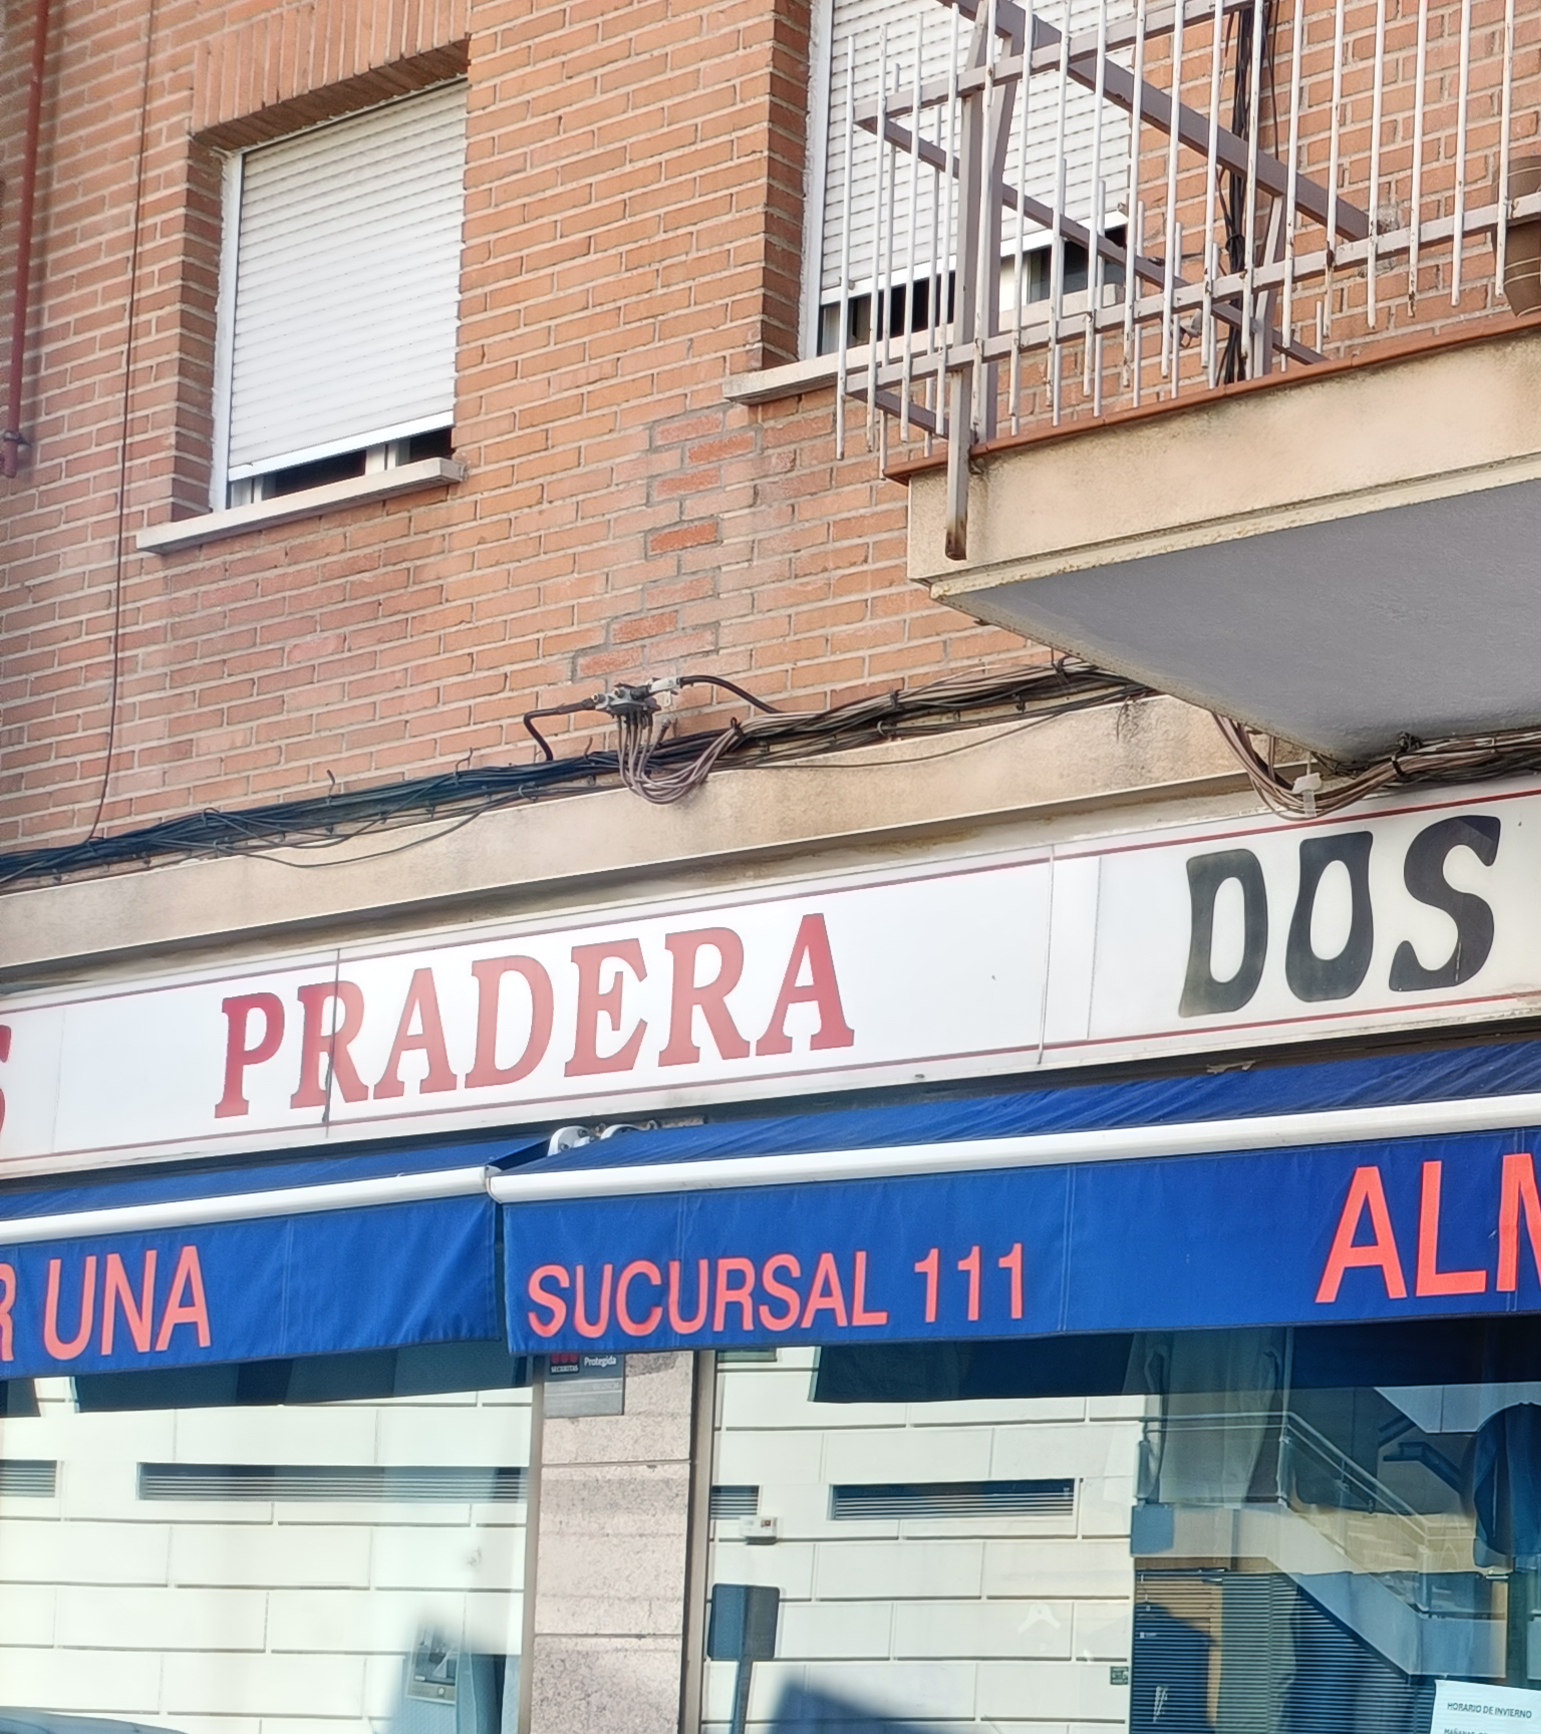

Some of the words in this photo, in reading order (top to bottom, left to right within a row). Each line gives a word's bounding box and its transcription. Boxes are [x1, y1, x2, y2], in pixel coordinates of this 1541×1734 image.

[1179, 815, 1501, 1017] DOS
[214, 913, 854, 1118] PRADERA
[44, 1246, 211, 1360] UNA
[527, 1251, 888, 1337] SUCURSAL
[915, 1243, 1025, 1322] 111
[584, 1355, 617, 1367] Protegida
[1447, 1702, 1481, 1713] HORARIO
[1483, 1706, 1493, 1714] DE
[1495, 1707, 1532, 1719] INVIERNO
